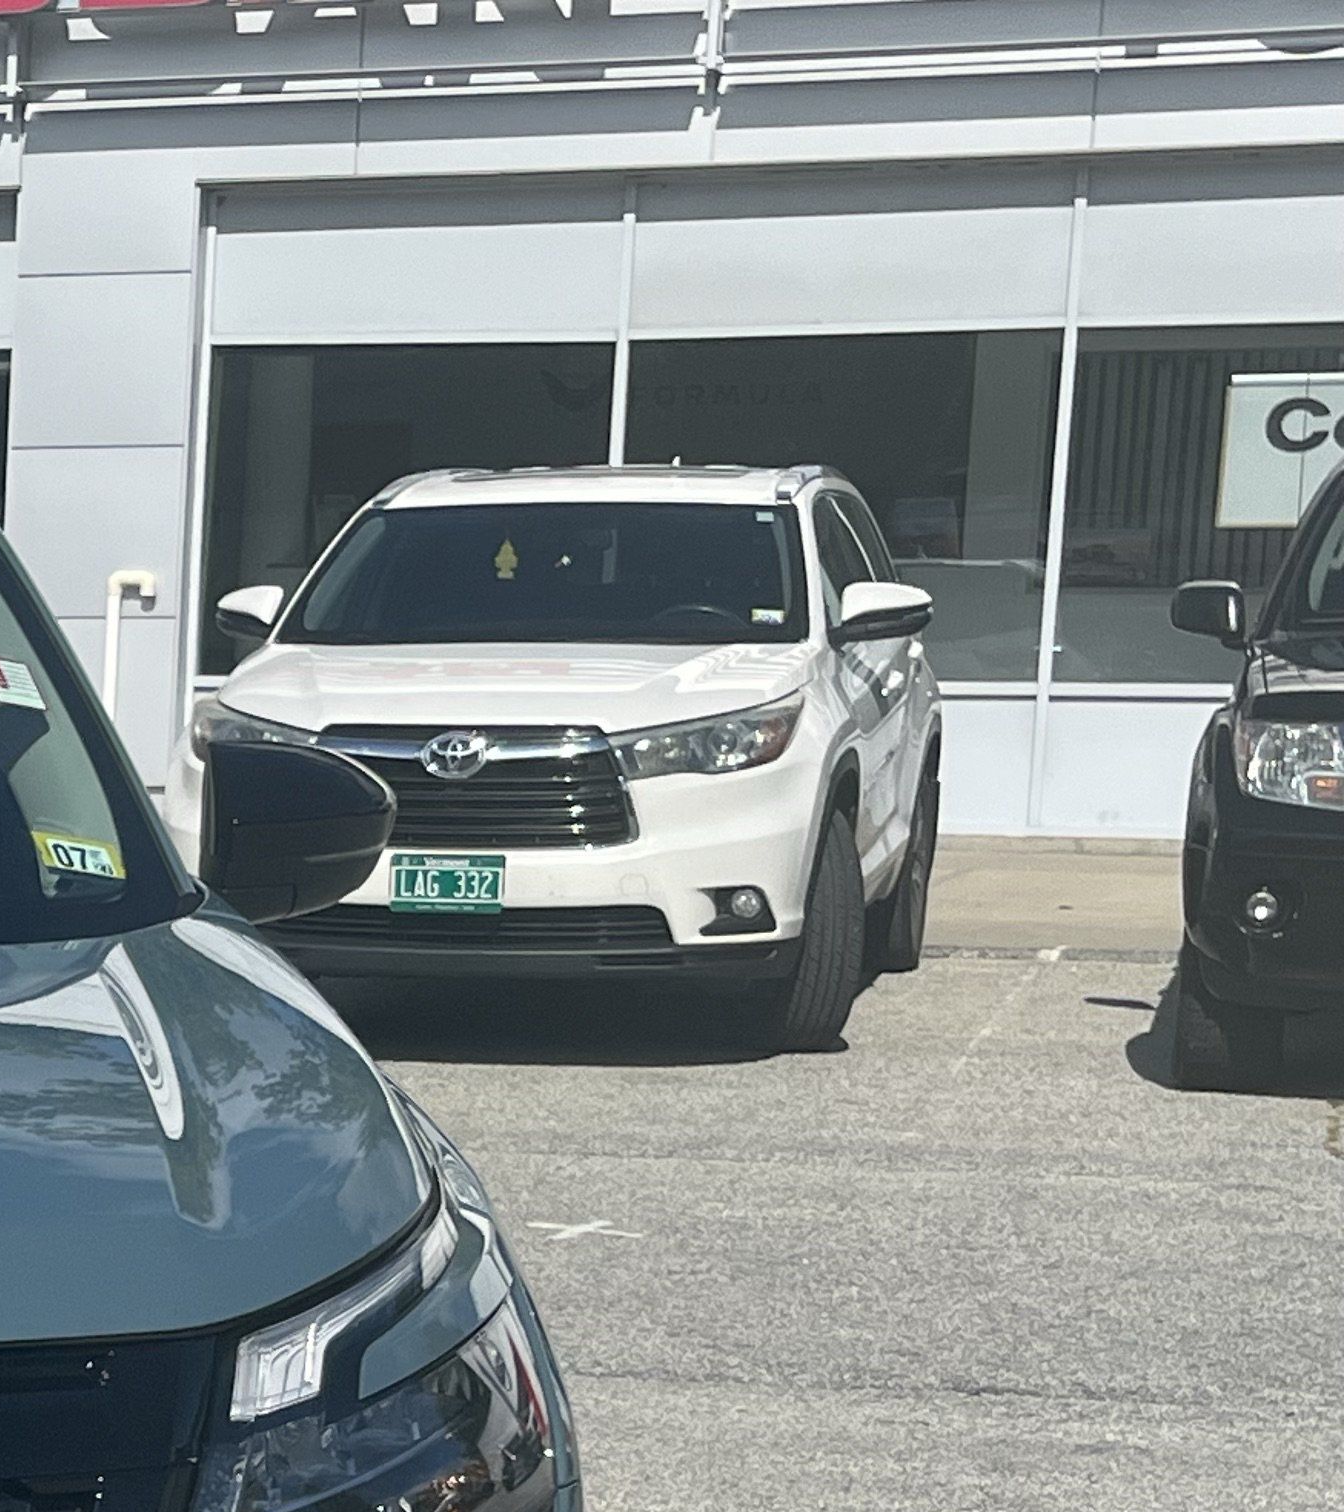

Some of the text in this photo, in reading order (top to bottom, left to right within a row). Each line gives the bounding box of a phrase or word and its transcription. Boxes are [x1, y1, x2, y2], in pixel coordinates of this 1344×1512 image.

[1265, 397, 1344, 453] C
[52, 843, 87, 870] 07
[400, 869, 493, 898] LAG 332
